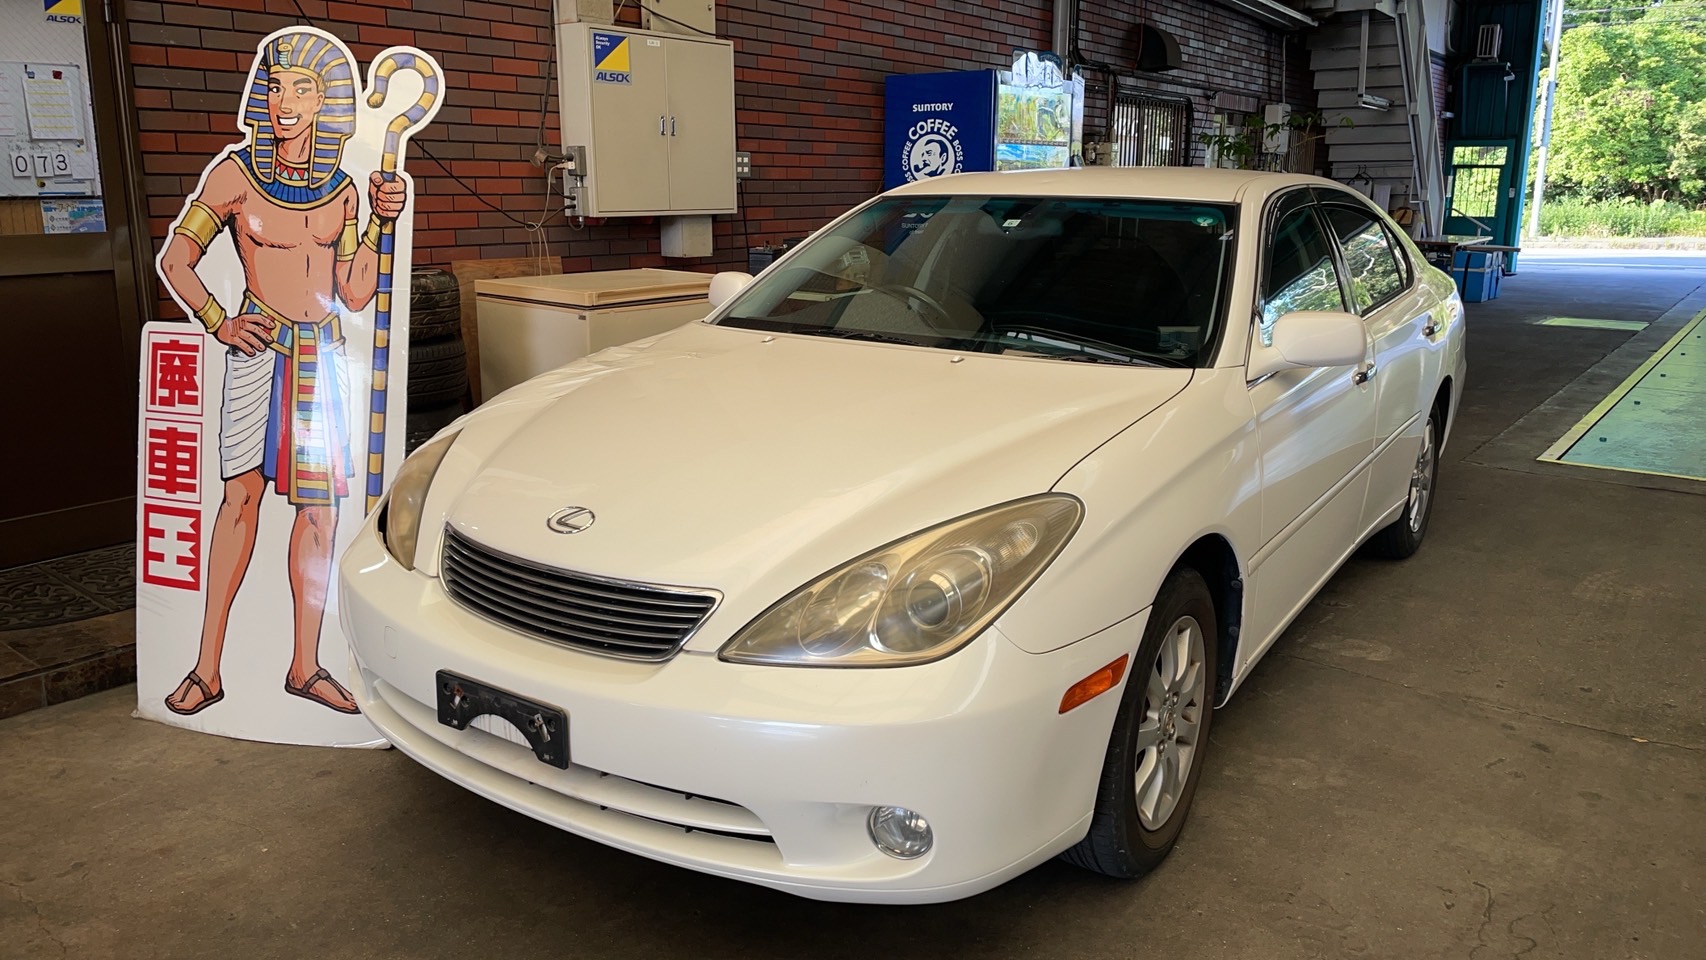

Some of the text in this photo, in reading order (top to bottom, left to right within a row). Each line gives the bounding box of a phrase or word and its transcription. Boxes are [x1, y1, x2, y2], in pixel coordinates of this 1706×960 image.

[46, 14, 82, 24] ALSOK
[596, 72, 630, 83] ALSOK
[912, 102, 954, 112] SUNTORY
[908, 118, 958, 140] COFFEE
[901, 141, 913, 171] COFFEE
[952, 139, 964, 161] BOSS
